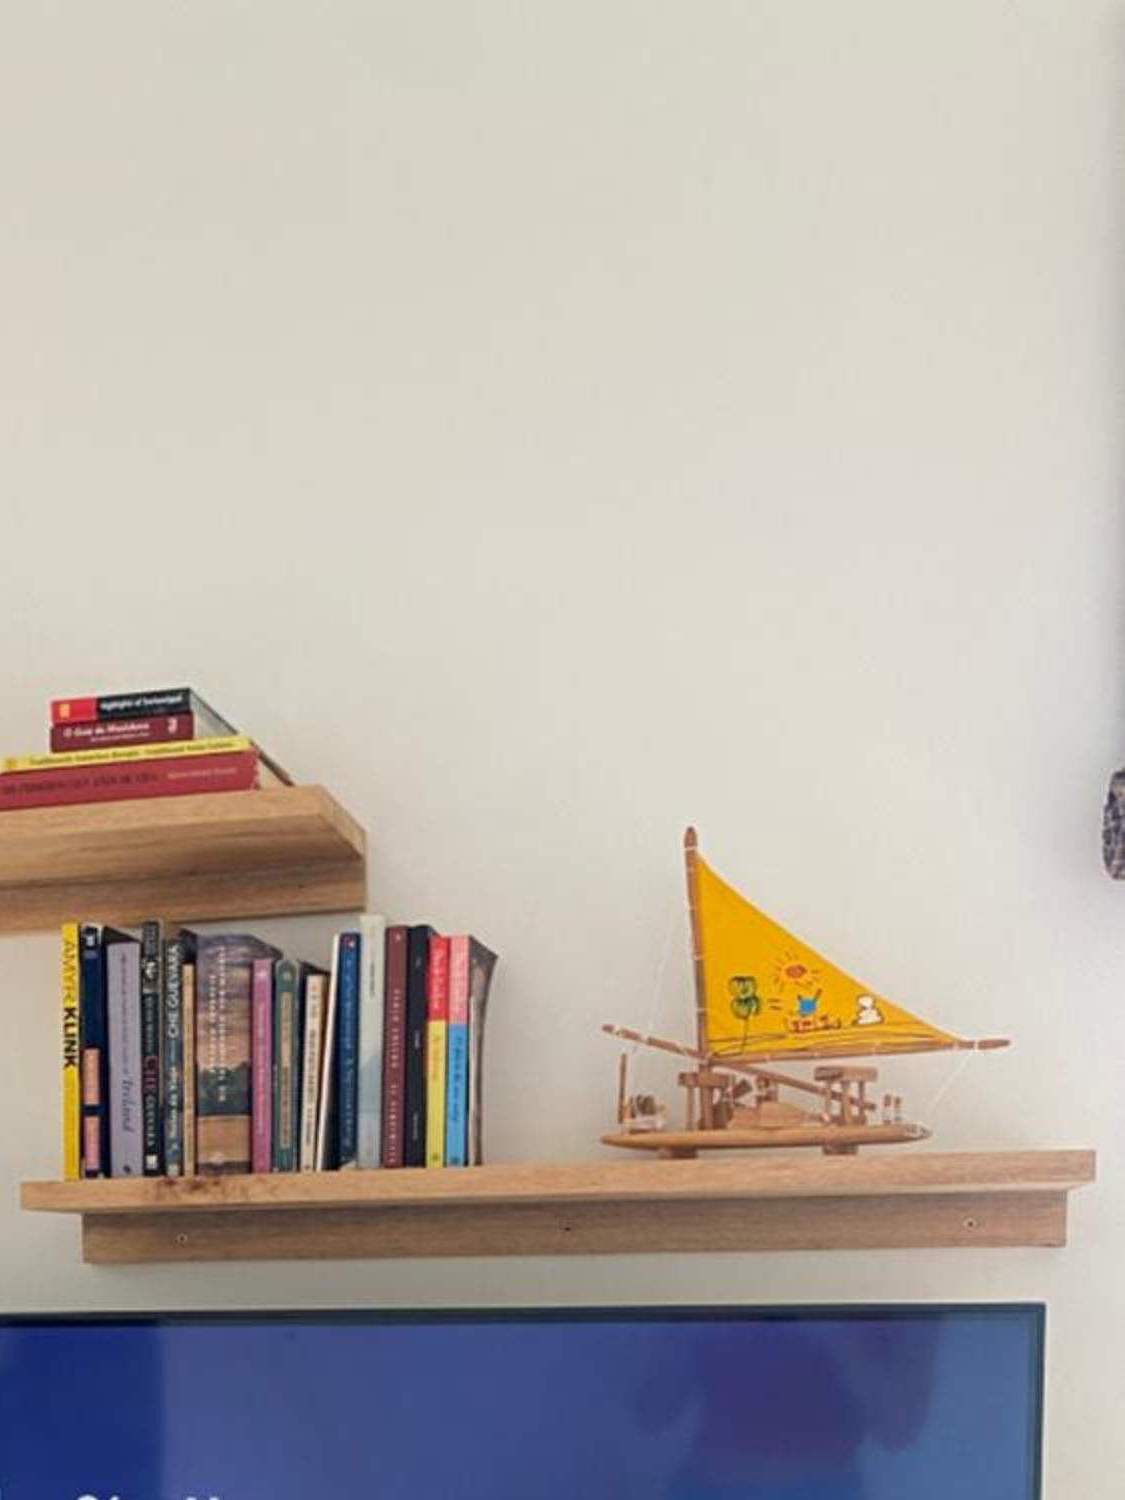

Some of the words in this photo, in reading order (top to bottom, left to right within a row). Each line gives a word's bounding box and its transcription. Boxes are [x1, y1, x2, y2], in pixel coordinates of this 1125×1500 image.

[63, 939, 77, 1003] AMYR
[166, 945, 181, 1009] GUEVARA
[63, 1006, 79, 1069] KLINK
[166, 1010, 181, 1038] CHE
